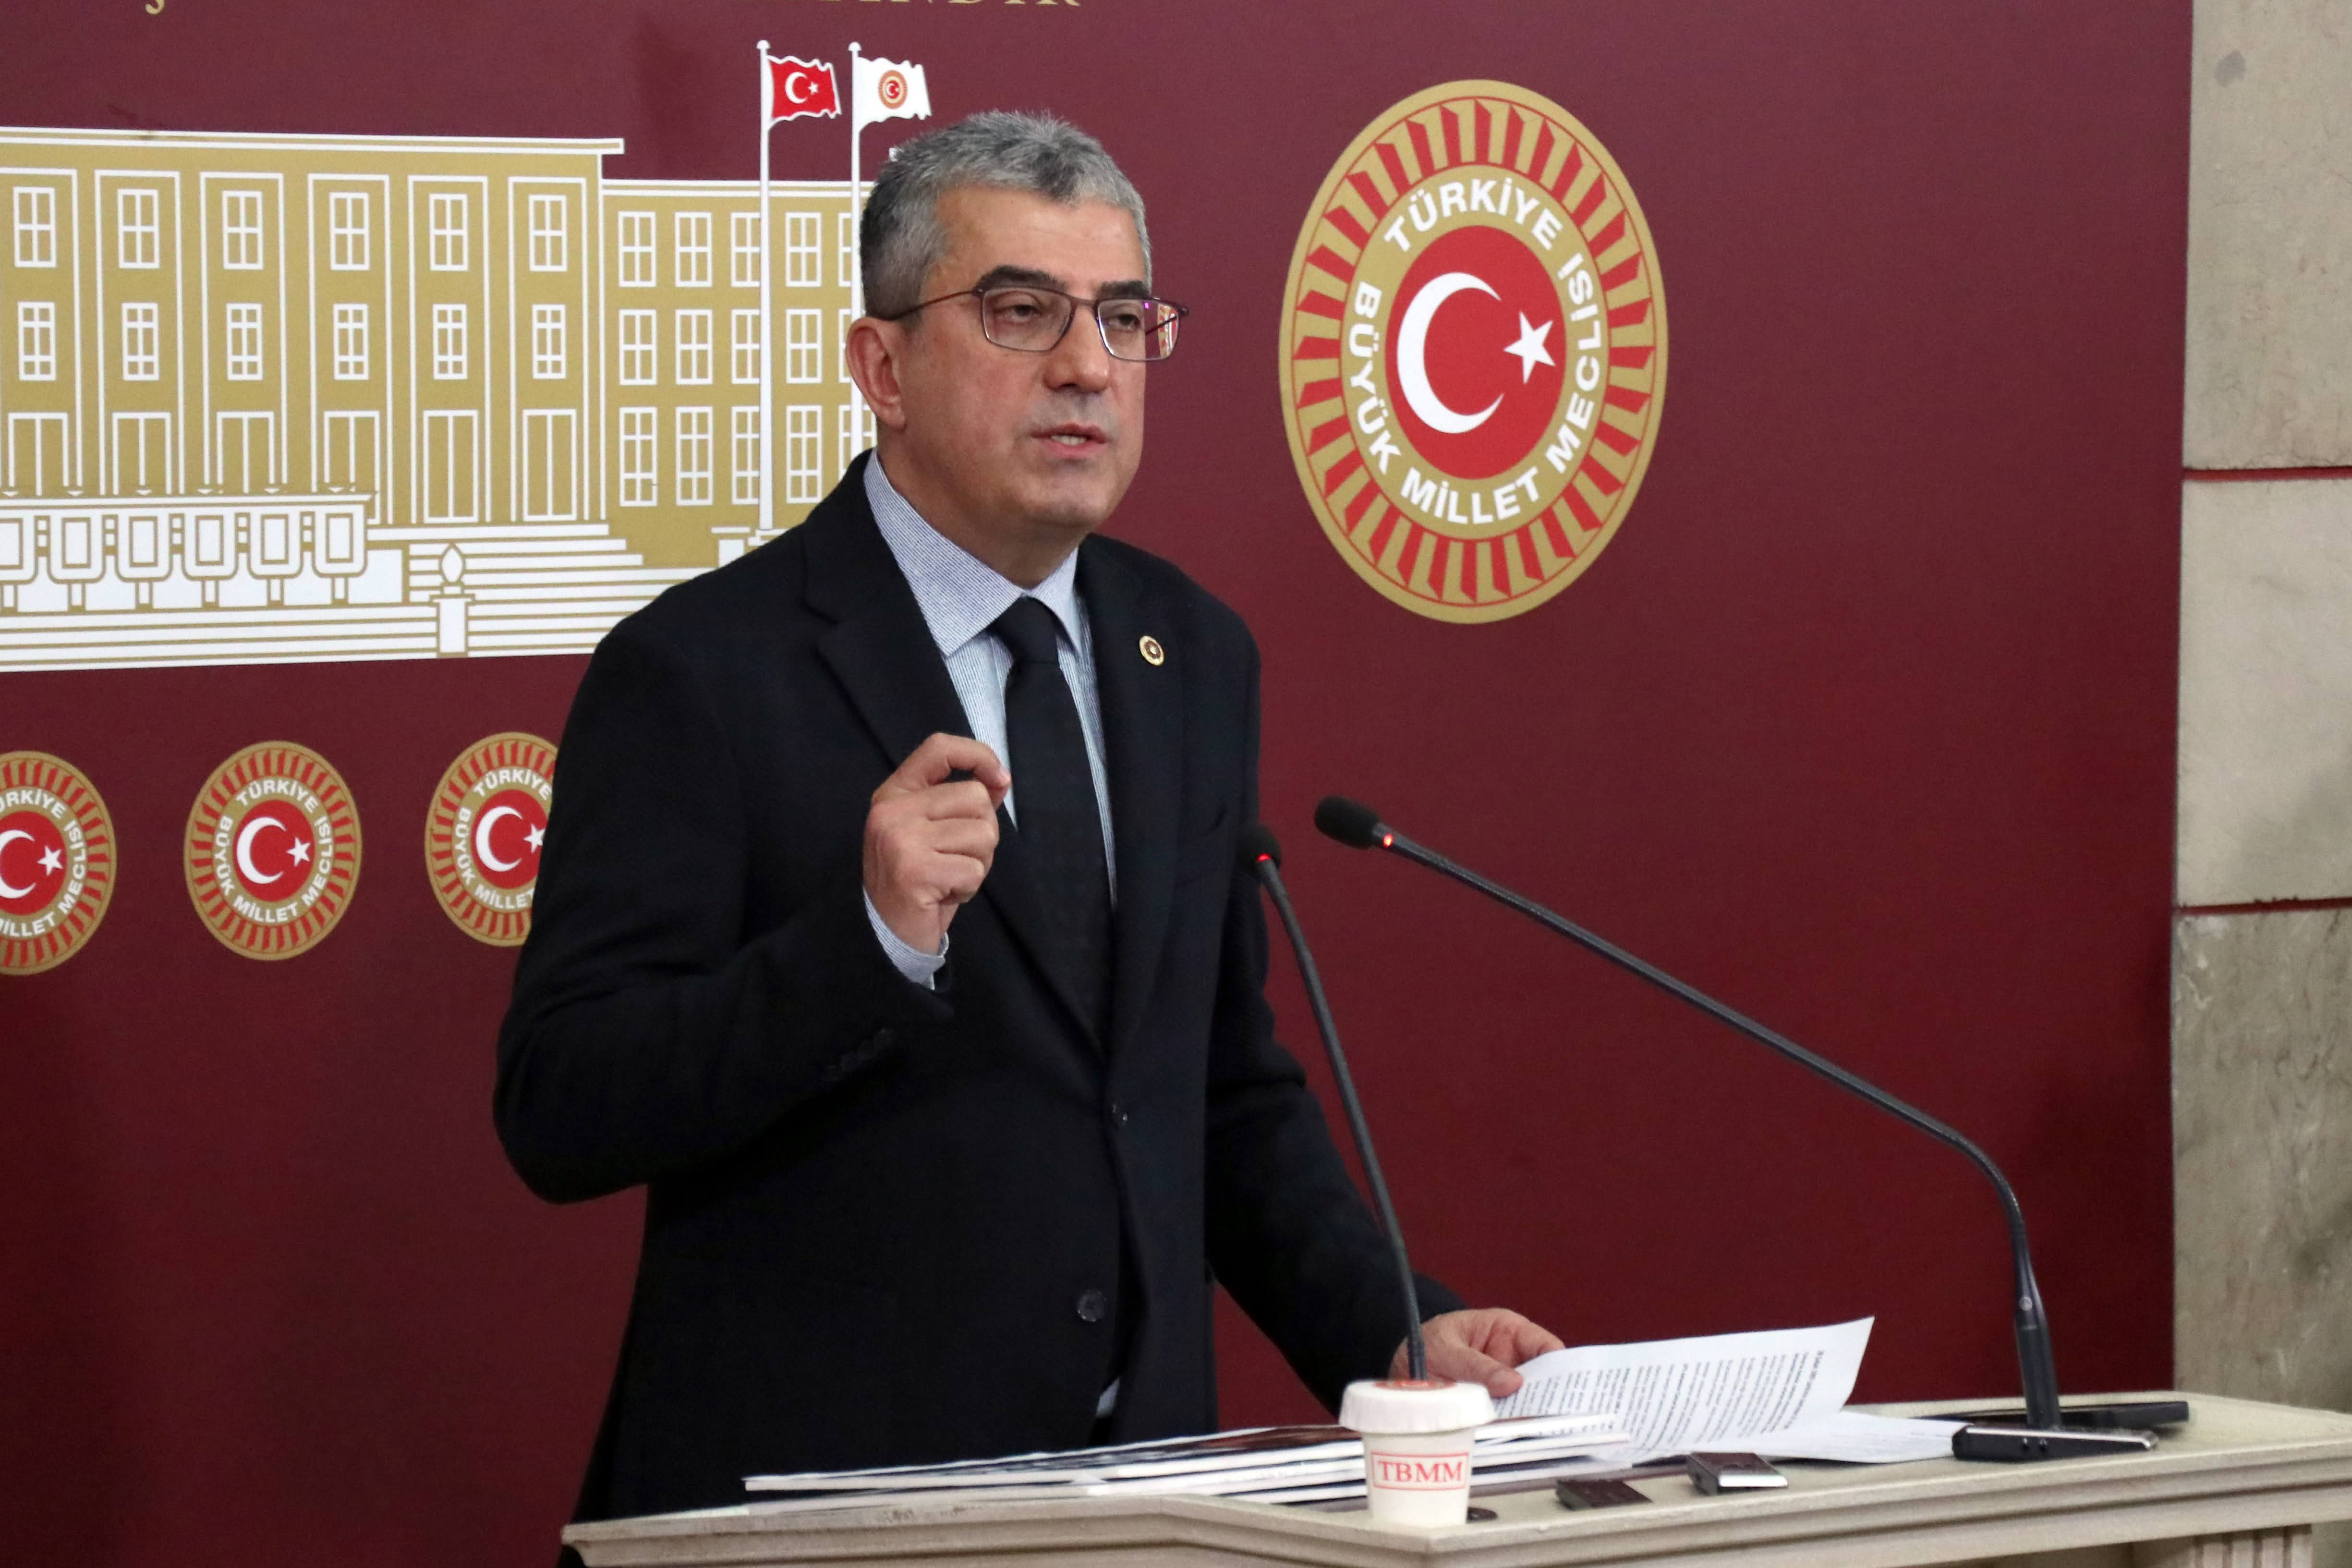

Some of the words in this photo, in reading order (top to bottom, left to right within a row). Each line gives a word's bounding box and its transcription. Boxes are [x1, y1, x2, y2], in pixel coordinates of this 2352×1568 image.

[1384, 178, 1562, 251] TÜRKİYE
[1349, 282, 1400, 473] BÜYÜK
[1401, 467, 1539, 524] MİLLET
[236, 779, 319, 814] TÜRKİYE
[473, 768, 552, 801] TÜRKİYE
[0, 789, 66, 819] RKİYE
[215, 815, 235, 897] BÜYÜK
[455, 807, 476, 885] BÜYÜK
[0, 912, 56, 937] İLLET
[233, 895, 298, 923] MİLLET
[1377, 1461, 1463, 1483] TBMM
